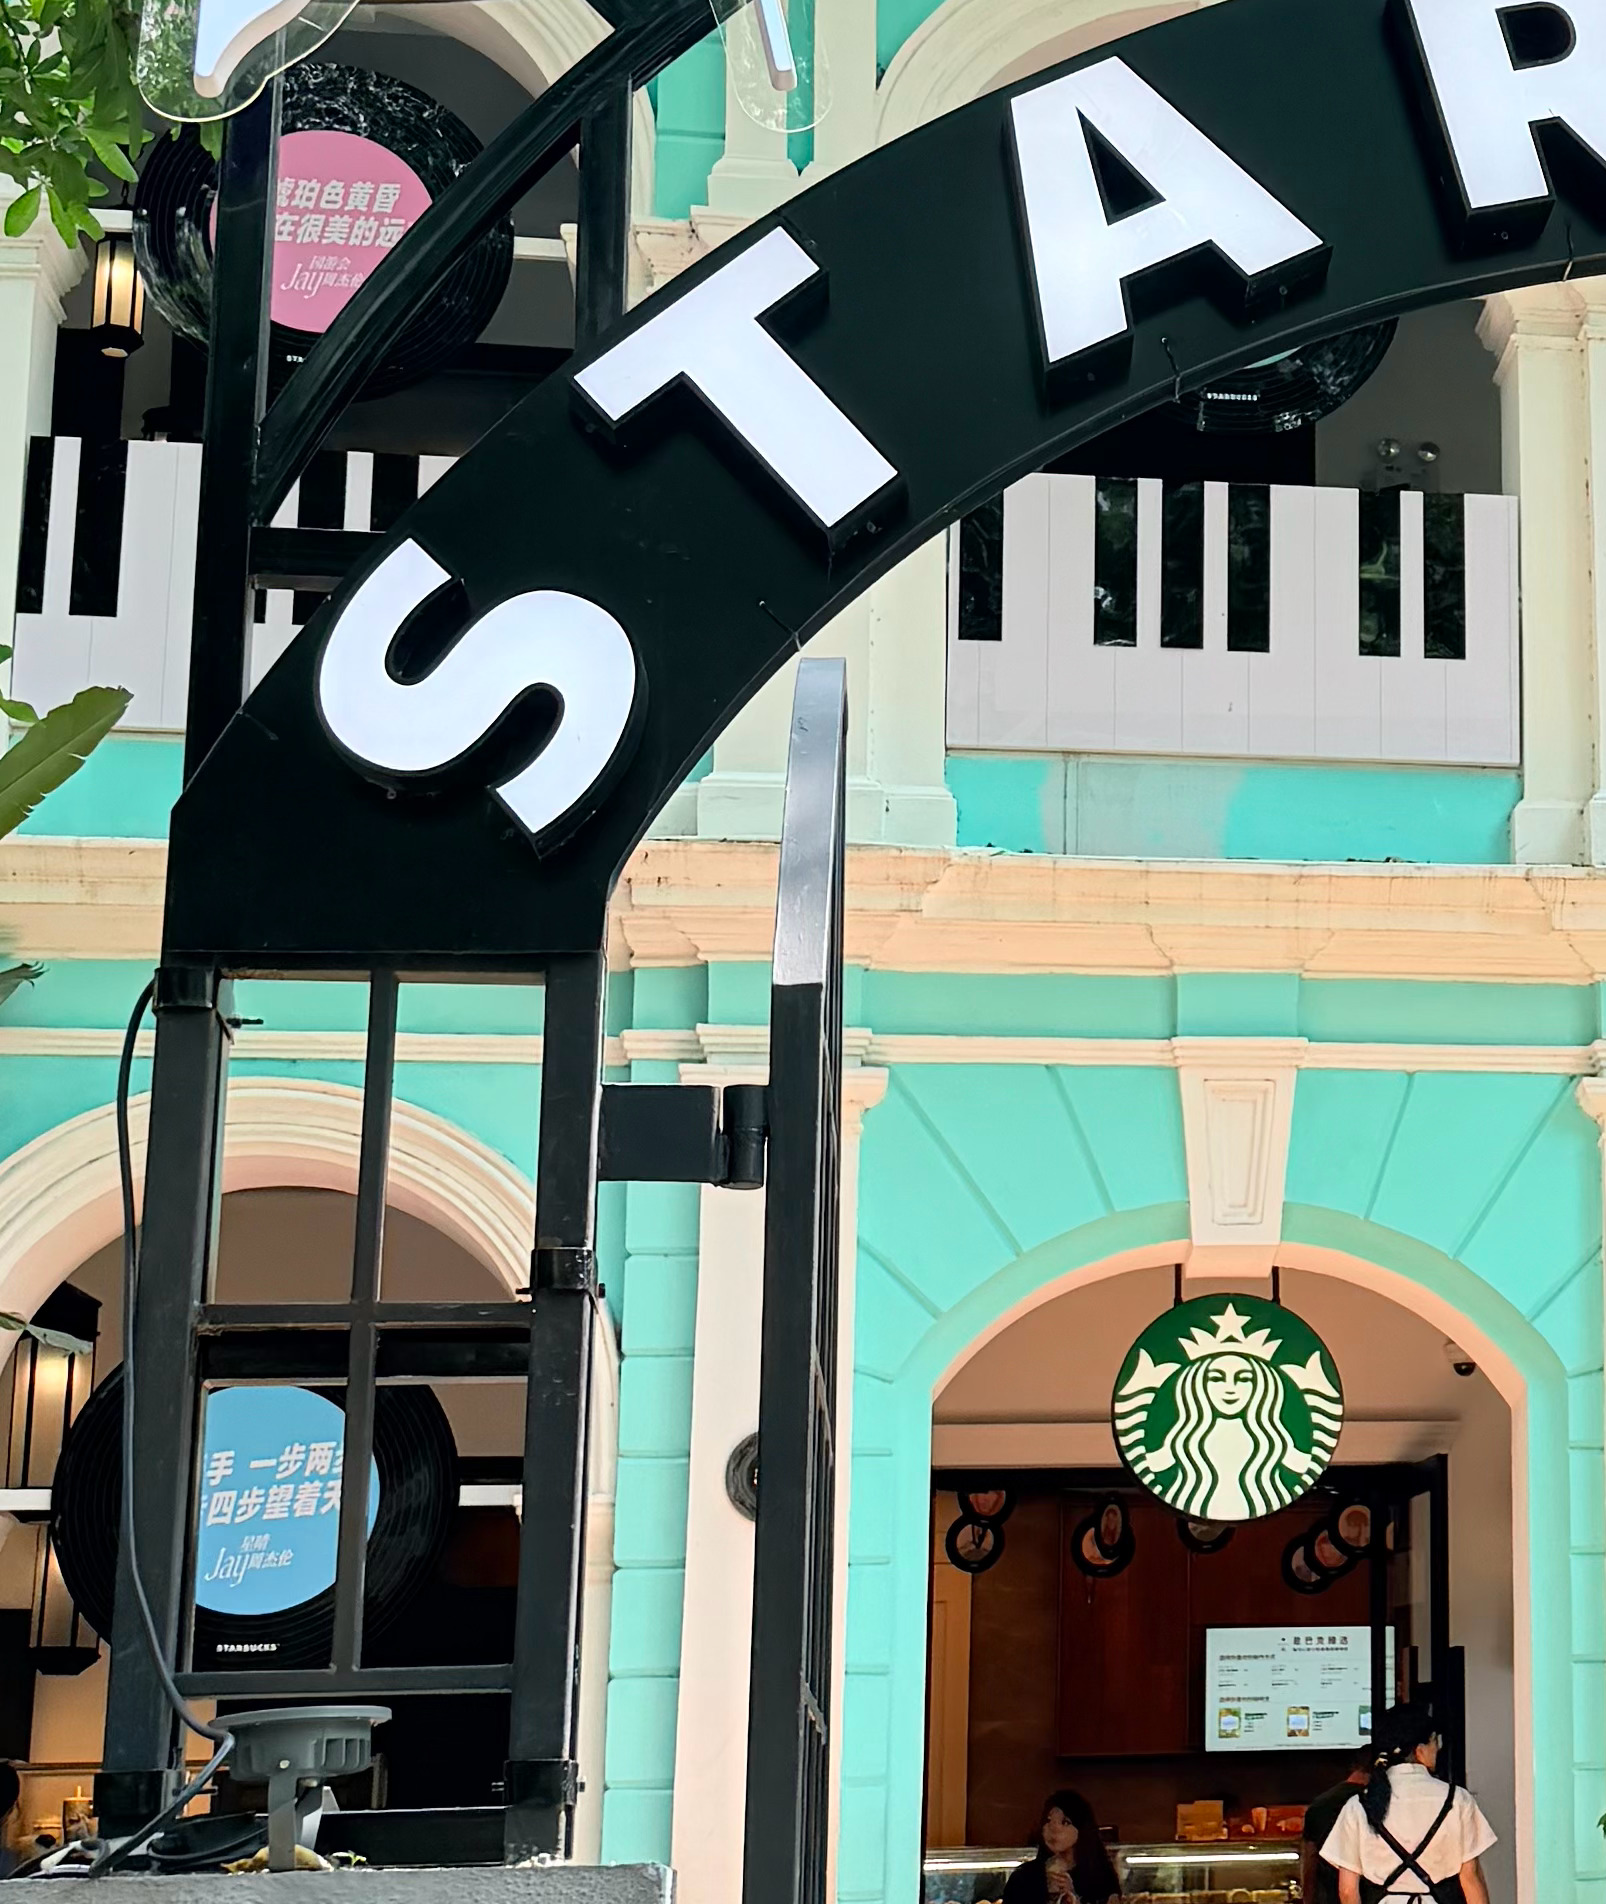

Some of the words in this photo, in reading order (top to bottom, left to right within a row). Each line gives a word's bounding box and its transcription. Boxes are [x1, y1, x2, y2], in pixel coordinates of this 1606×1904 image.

[274, 212, 413, 248] 在很美的远
[201, 1479, 342, 1527] 四步望着天
